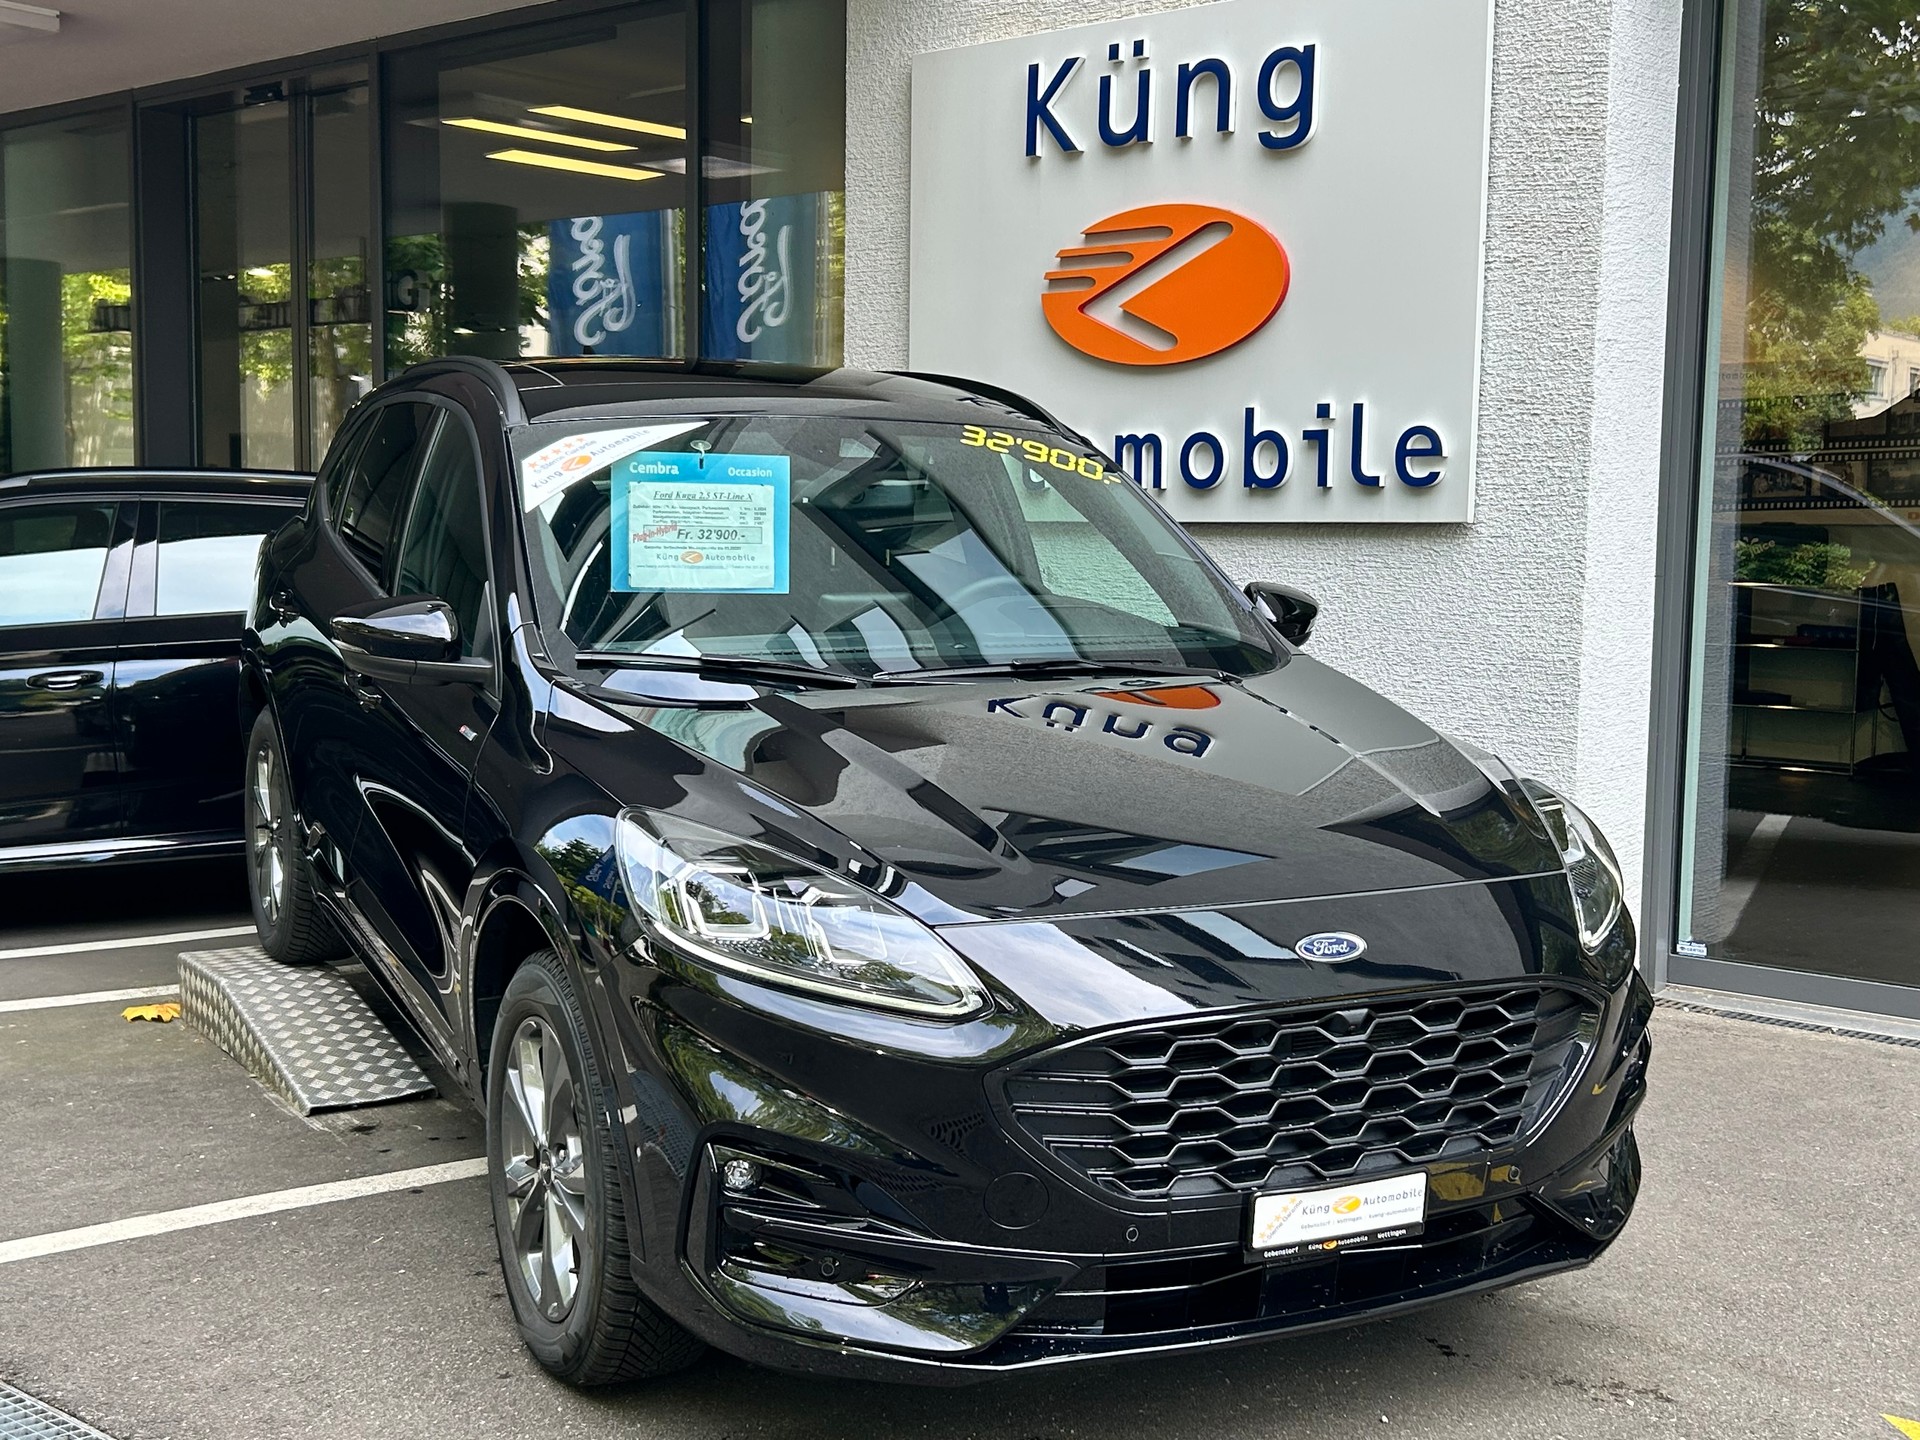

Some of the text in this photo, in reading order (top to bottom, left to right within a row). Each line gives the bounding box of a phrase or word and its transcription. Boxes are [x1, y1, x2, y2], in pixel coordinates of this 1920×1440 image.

[1025, 39, 1321, 158] Küng
[589, 429, 651, 457] Automobile
[1114, 402, 1449, 490] mobile
[960, 425, 1122, 485] 32'900.-
[629, 462, 679, 475] Cembra
[727, 467, 773, 478] Occasion
[653, 490, 673, 500] Ford
[674, 490, 697, 500] Kuga
[676, 528, 746, 541] Fr. 32'900.-
[656, 553, 756, 562] Küng Automobile
[1313, 938, 1350, 955] Ford
[1302, 1188, 1423, 1216] Küng Automobile
[1264, 1246, 1299, 1258] Gebenstorf
[1338, 1235, 1369, 1245] Automobile
